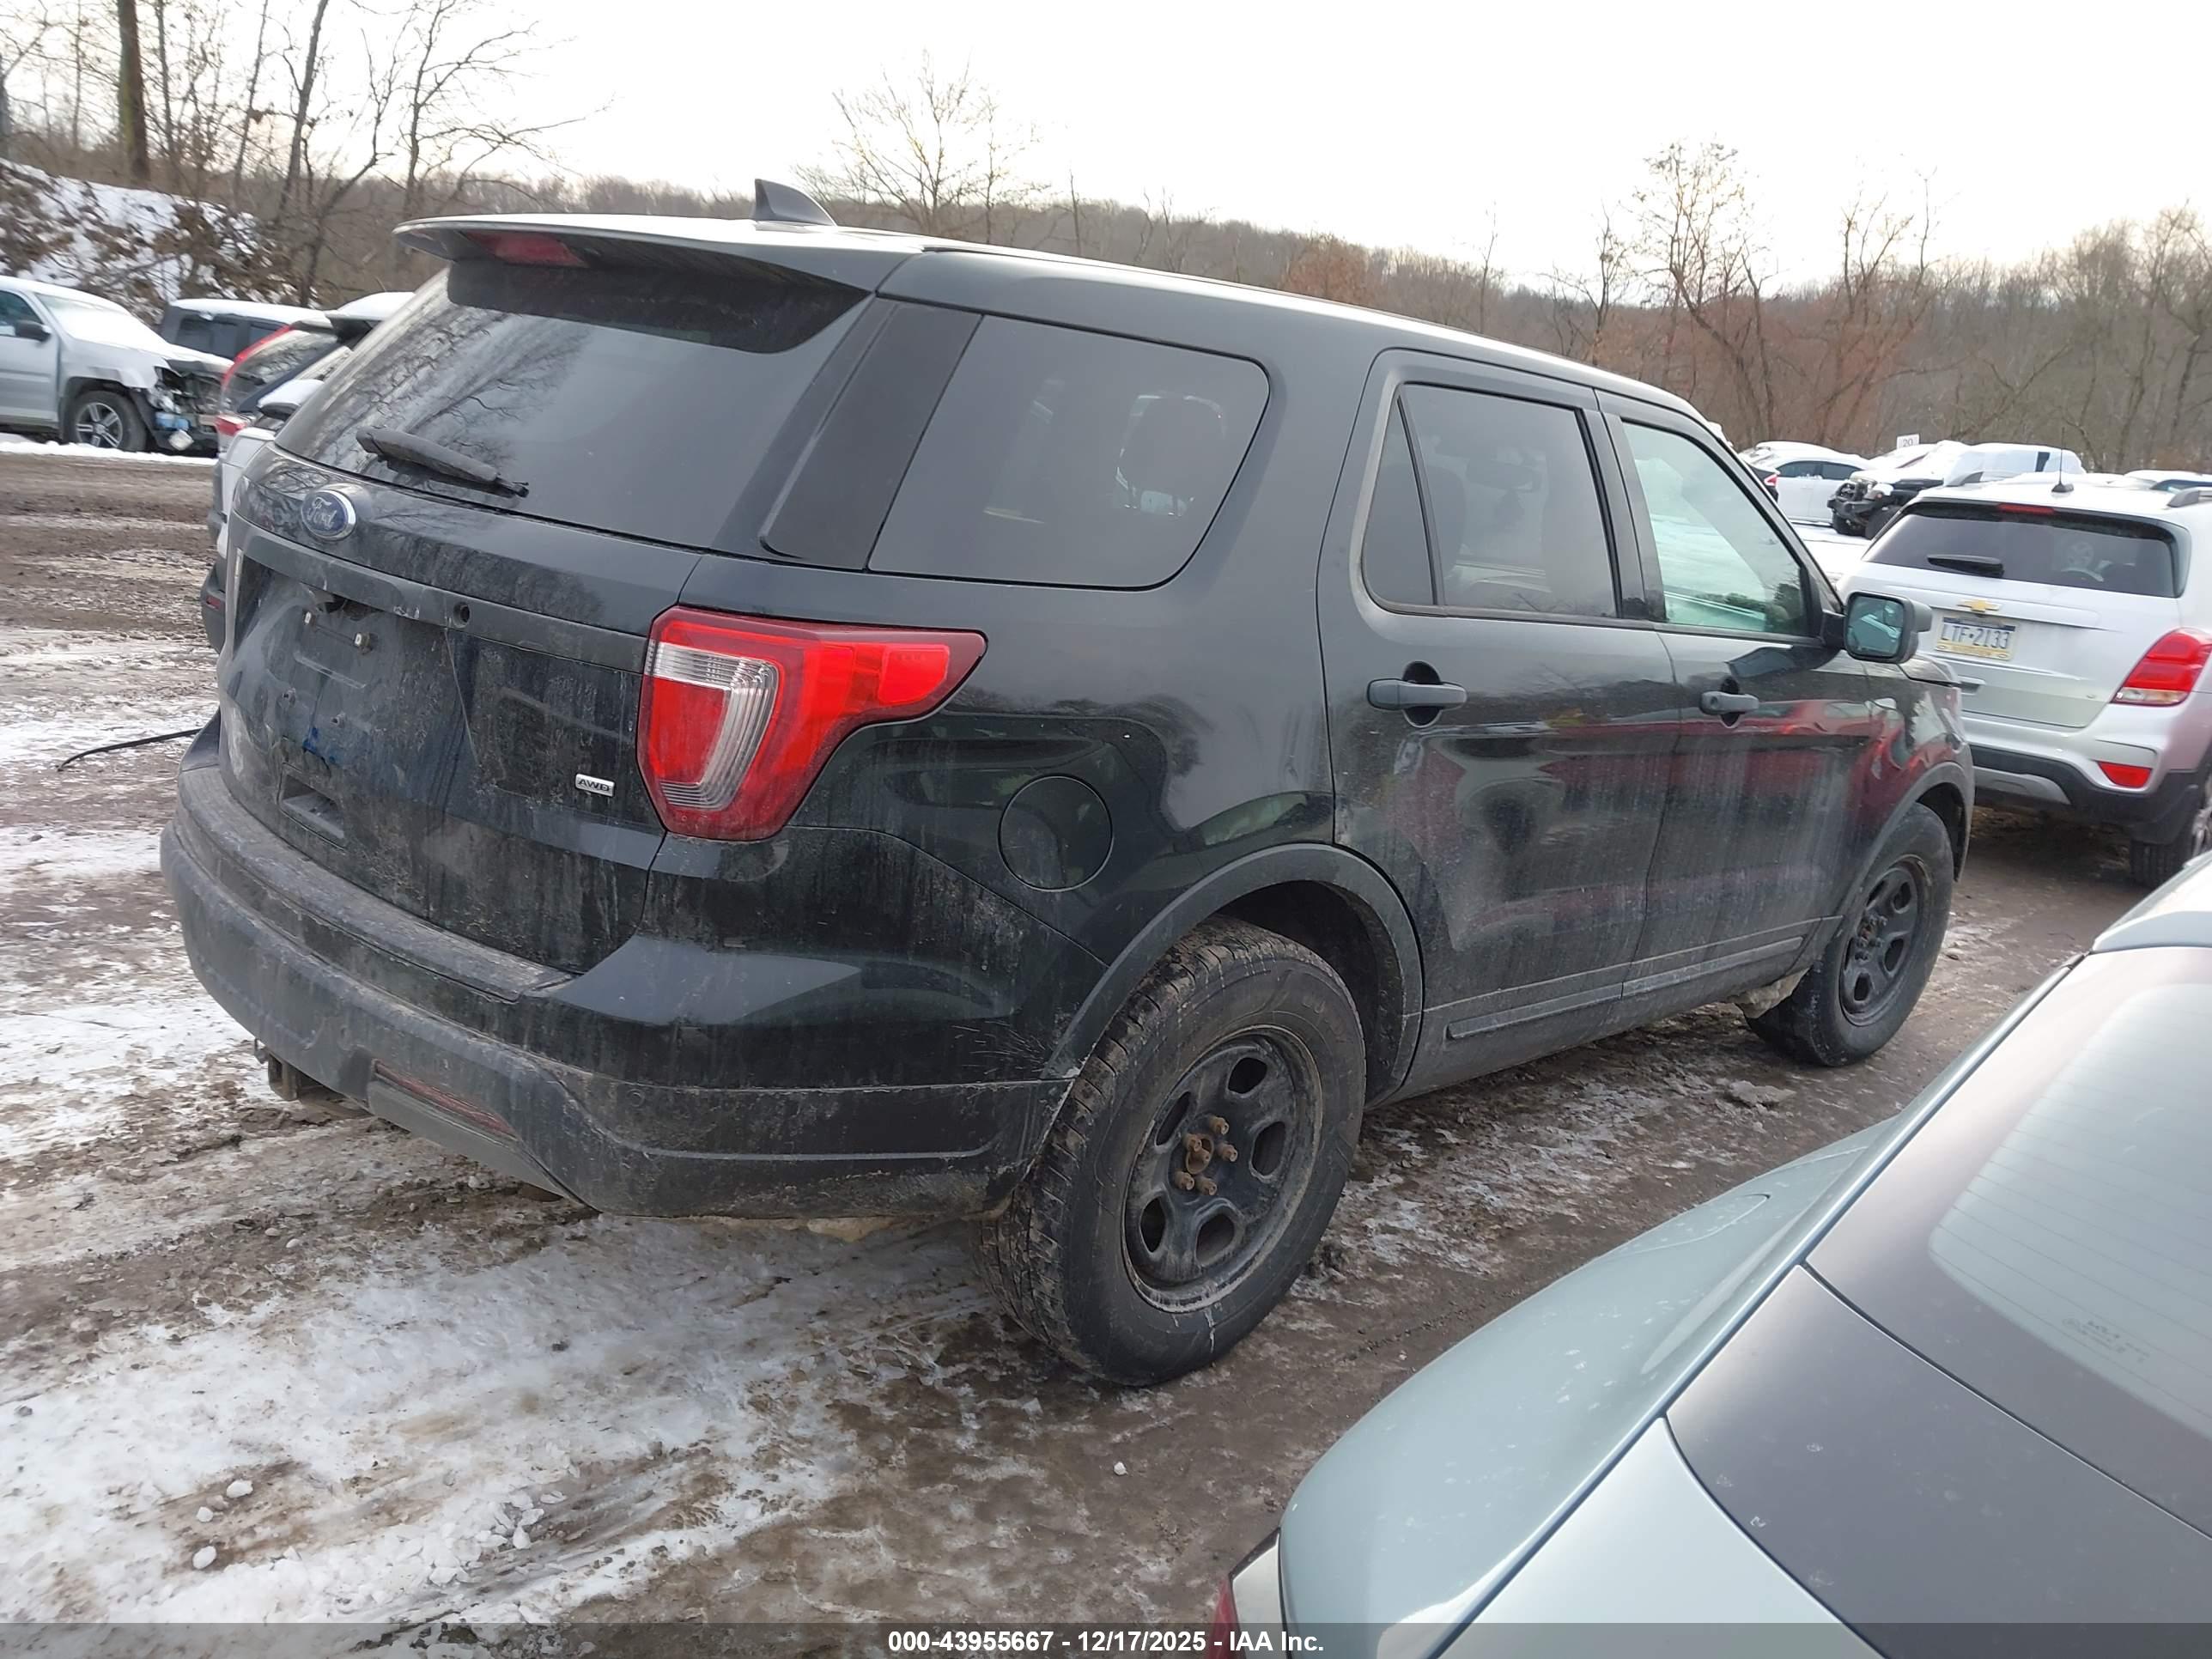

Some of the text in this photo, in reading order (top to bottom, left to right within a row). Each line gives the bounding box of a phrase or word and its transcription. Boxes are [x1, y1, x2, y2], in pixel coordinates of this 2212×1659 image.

[1902, 438, 1914, 447] 20
[307, 496, 337, 530] Ford
[578, 778, 610, 792] AWD
